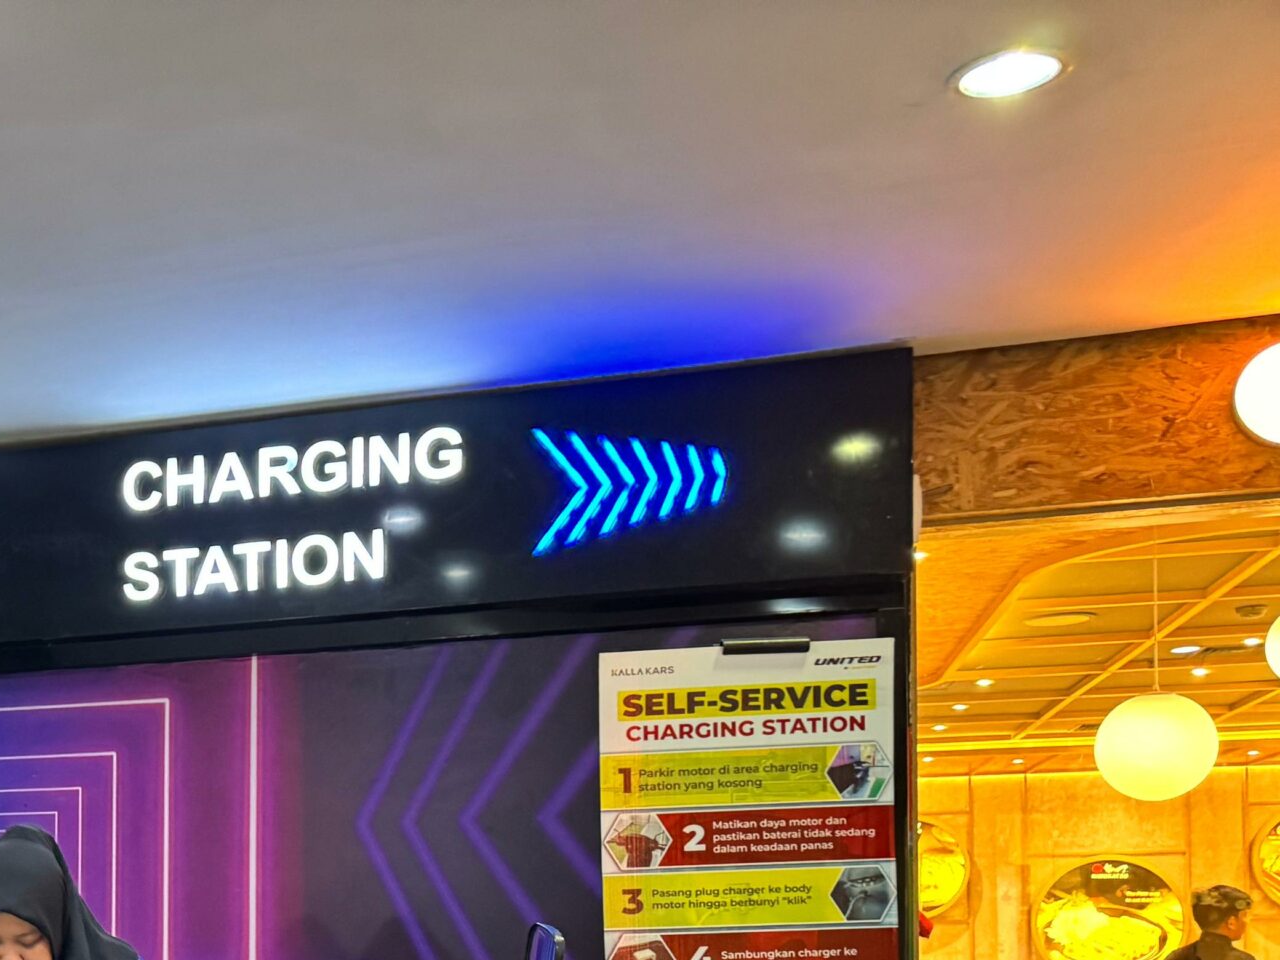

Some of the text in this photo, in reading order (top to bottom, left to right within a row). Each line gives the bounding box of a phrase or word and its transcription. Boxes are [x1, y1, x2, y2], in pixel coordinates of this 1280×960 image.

[122, 426, 464, 512] CHARGING
[123, 528, 386, 602] STATION
[814, 655, 882, 666] UNITED
[645, 666, 675, 675] KARS
[622, 683, 869, 717] SELF-SERVICE
[626, 715, 866, 742] CHARGING STATION
[639, 762, 818, 778] Parkir motor di area charging
[618, 767, 632, 793] 1
[638, 777, 762, 792] station yang kosong
[712, 816, 847, 830] Matikan daya motor dan
[682, 824, 706, 851] 2
[713, 827, 876, 843] pastikan baterai tidak sedang
[713, 841, 833, 854] dalam keadaan panas
[652, 884, 812, 899] Pasang plug charger ke body
[621, 888, 644, 915] 3
[652, 901, 685, 910] motor
[688, 899, 727, 910] hingga
[730, 897, 780, 908] berbunyi
[721, 947, 858, 960] Sambungkan charger ke
